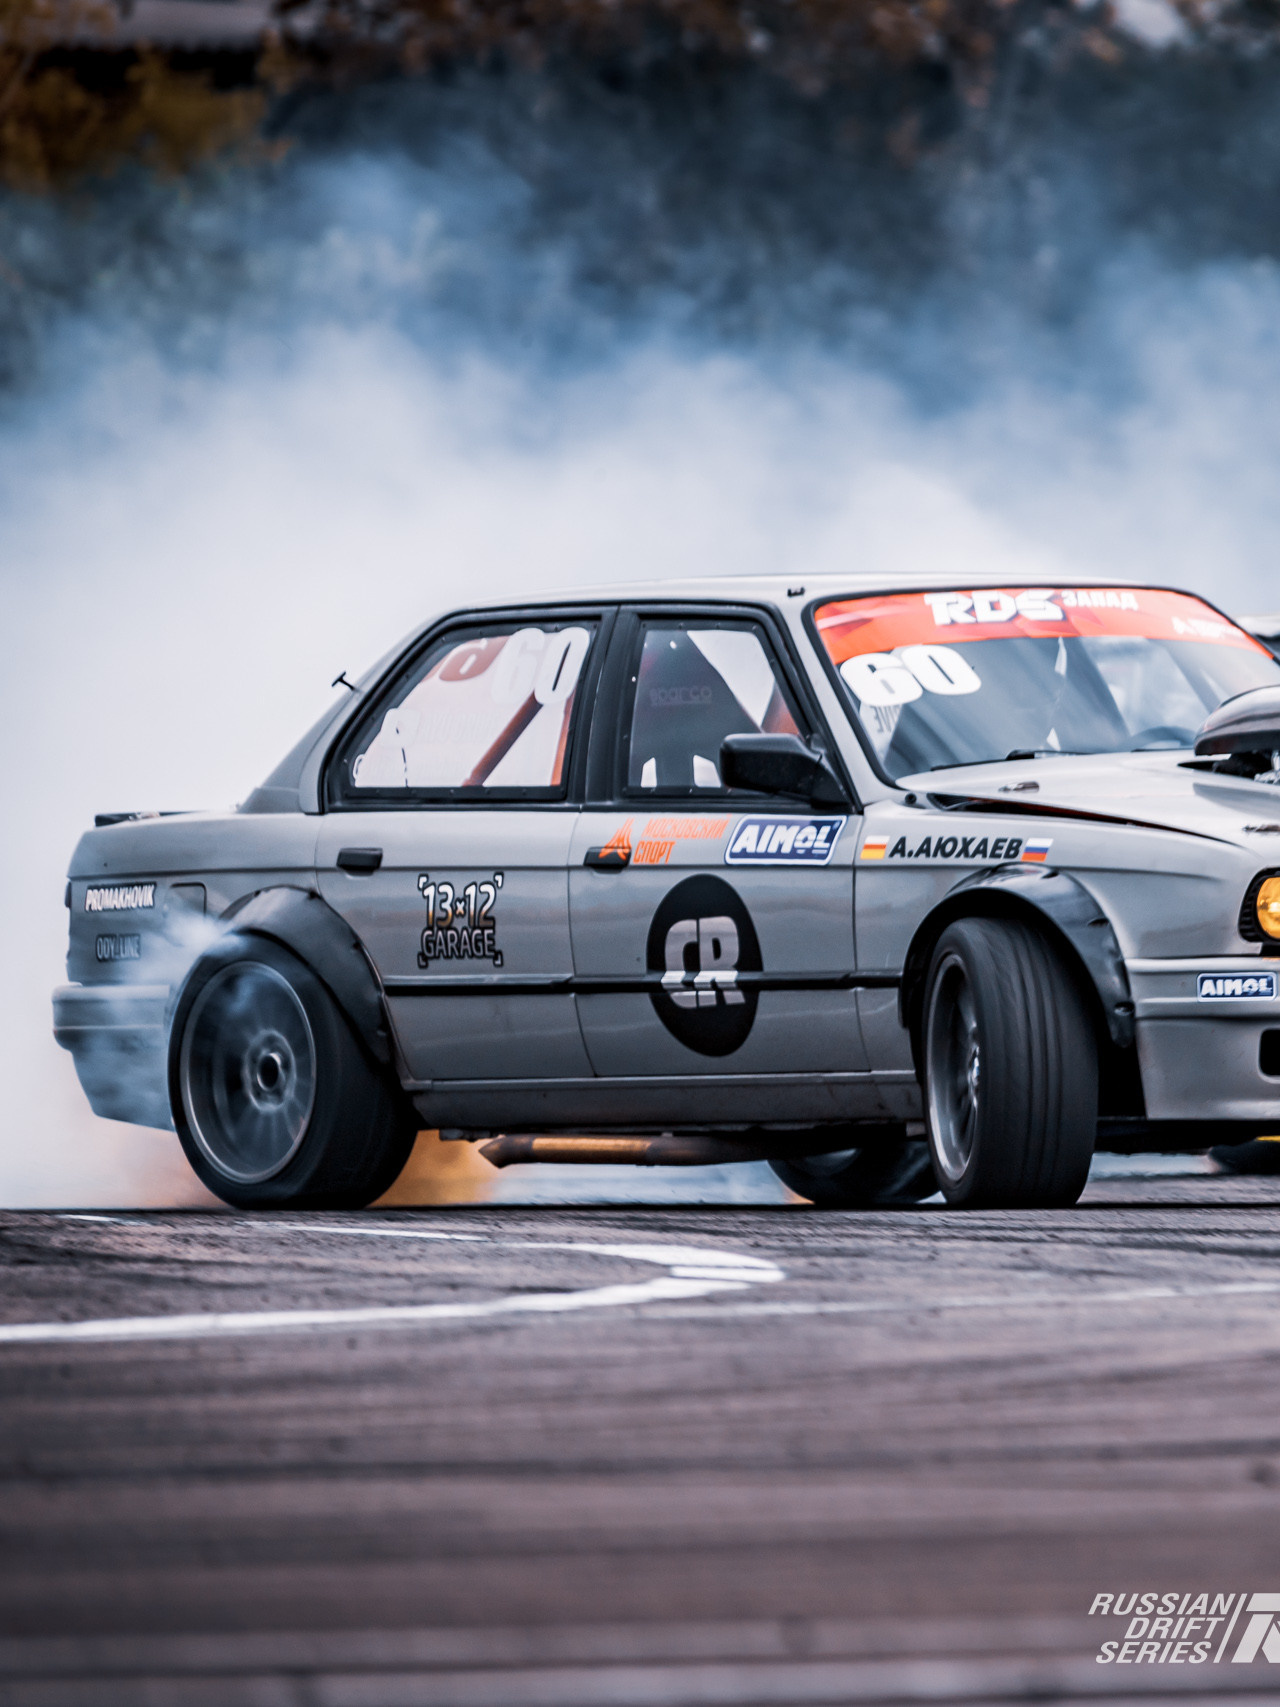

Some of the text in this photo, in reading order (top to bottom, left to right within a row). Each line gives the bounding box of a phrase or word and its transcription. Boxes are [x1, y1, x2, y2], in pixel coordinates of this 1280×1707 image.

[924, 589, 1064, 626] RDS
[490, 626, 591, 705] 60
[840, 645, 981, 705] 60
[632, 841, 676, 864] СПОРТ
[86, 885, 155, 912] PROMAKHOVIK
[422, 927, 496, 958] GARAGE
